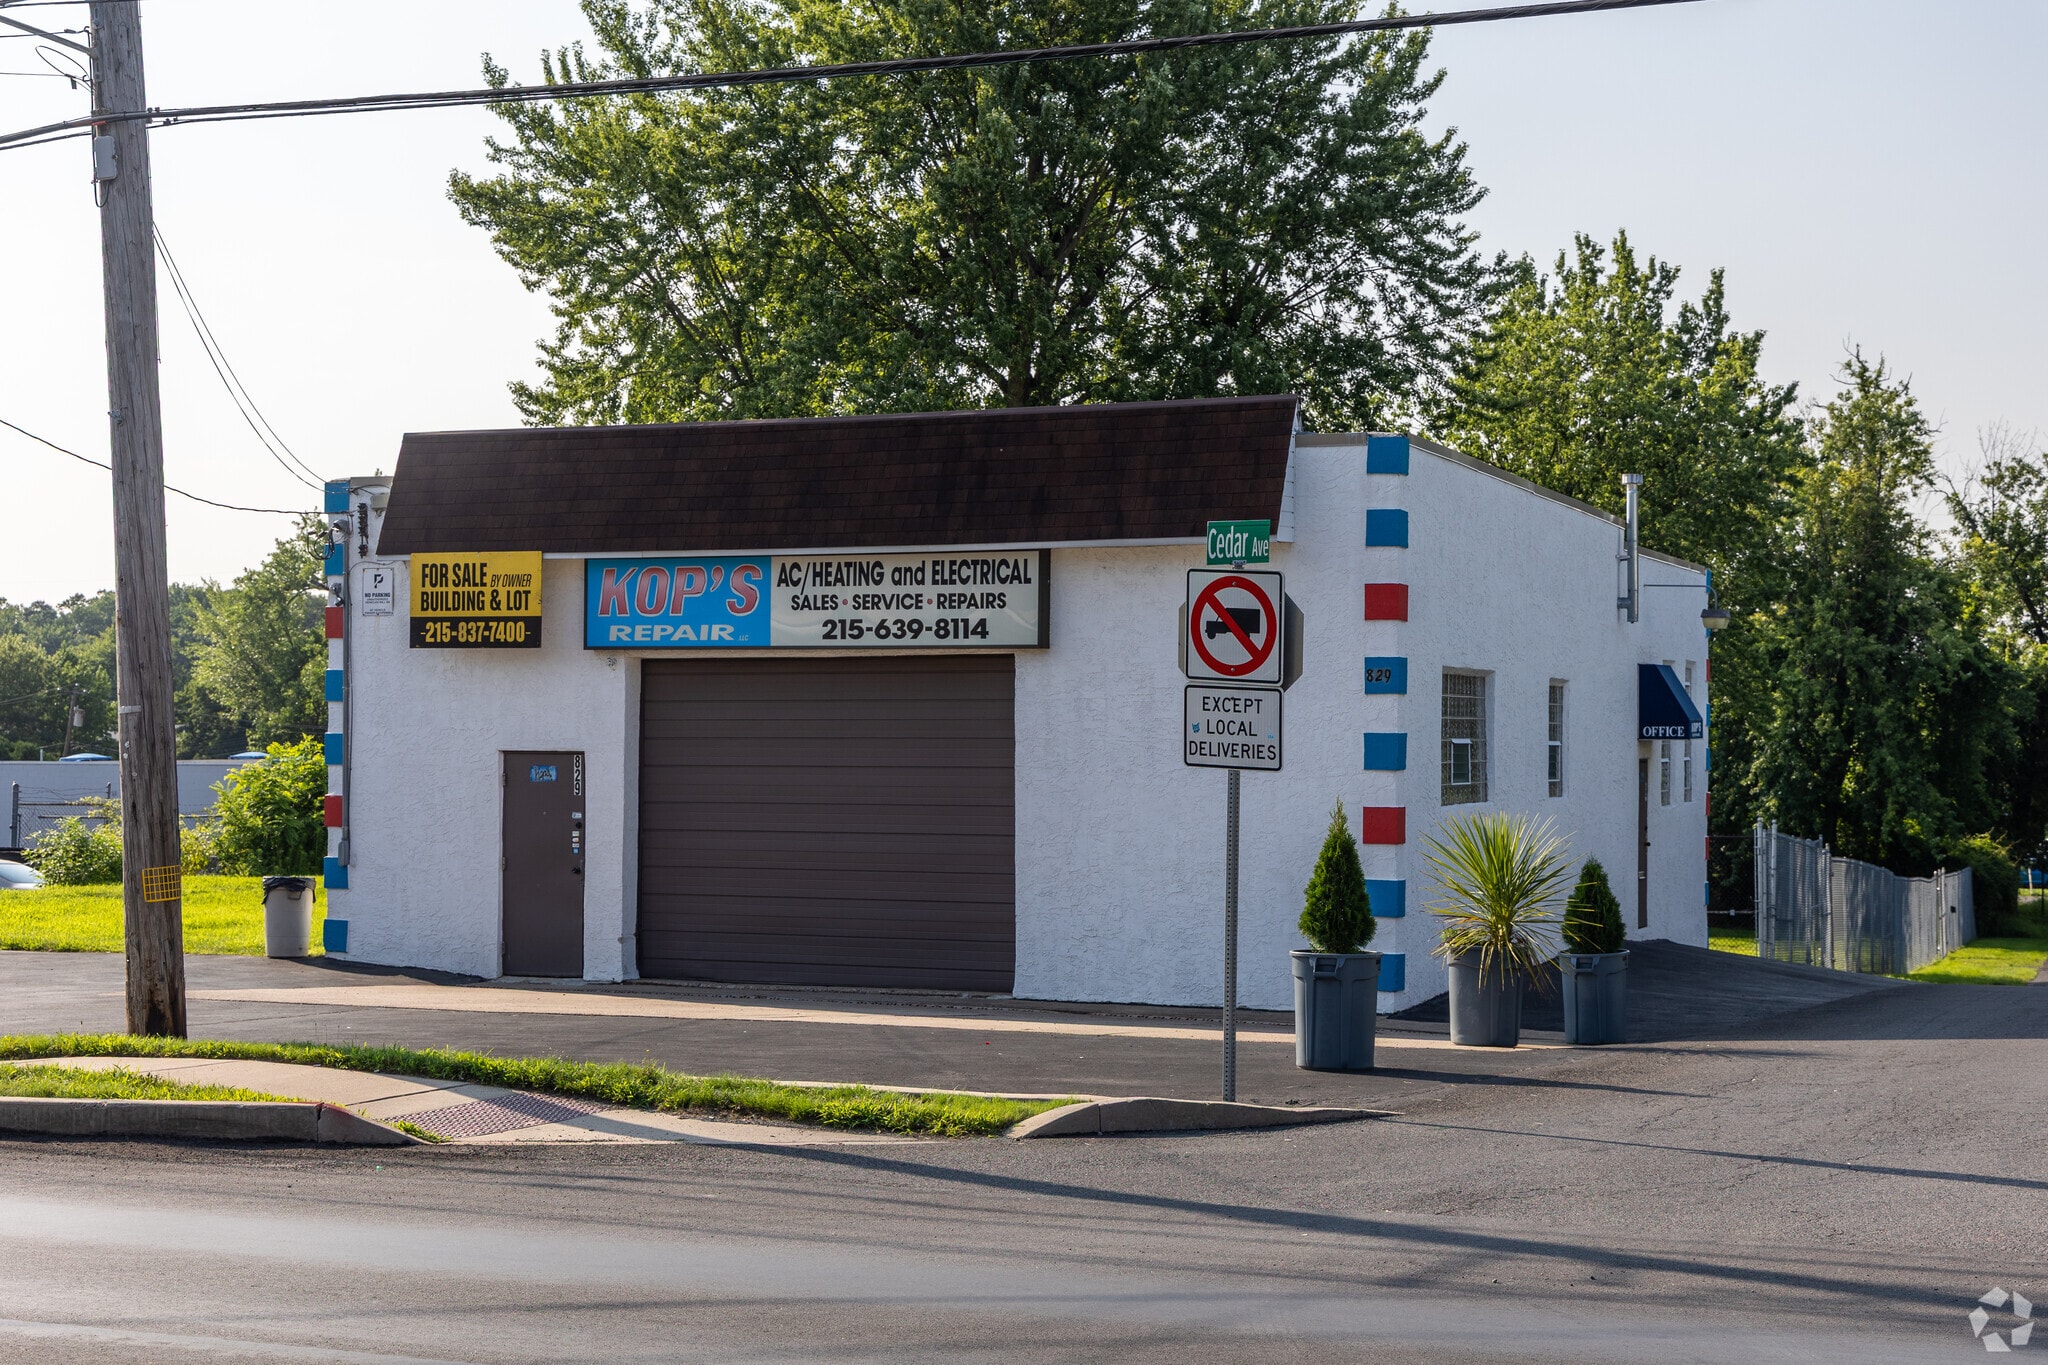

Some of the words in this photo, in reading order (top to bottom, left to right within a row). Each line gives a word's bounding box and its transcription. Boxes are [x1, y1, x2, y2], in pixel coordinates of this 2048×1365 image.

[1208, 525, 1249, 559] Cedar
[1252, 537, 1269, 557] Ave
[421, 563, 449, 588] FOR
[452, 562, 487, 588] SALE
[490, 574, 502, 587] BY
[502, 573, 532, 587] OWNER
[777, 560, 885, 595] AC/HEATING
[891, 560, 925, 587] and
[931, 558, 1032, 586] ELECTRICAL
[420, 590, 486, 612] BUILDING
[490, 589, 502, 611] &
[506, 590, 531, 611] LOT
[598, 564, 763, 617] KOP'S
[791, 594, 839, 611] SALES
[852, 593, 923, 611] SERVICE
[936, 592, 1007, 610] REPAIRS
[609, 624, 735, 641] REPAIR
[822, 618, 989, 640] 215-639-8114
[1366, 668, 1391, 684] 829
[1202, 696, 1263, 714] EXCEPT
[1207, 719, 1258, 737] LOCAL
[1643, 726, 1685, 737] OFFICE
[1189, 740, 1277, 761] DELIVERIES
